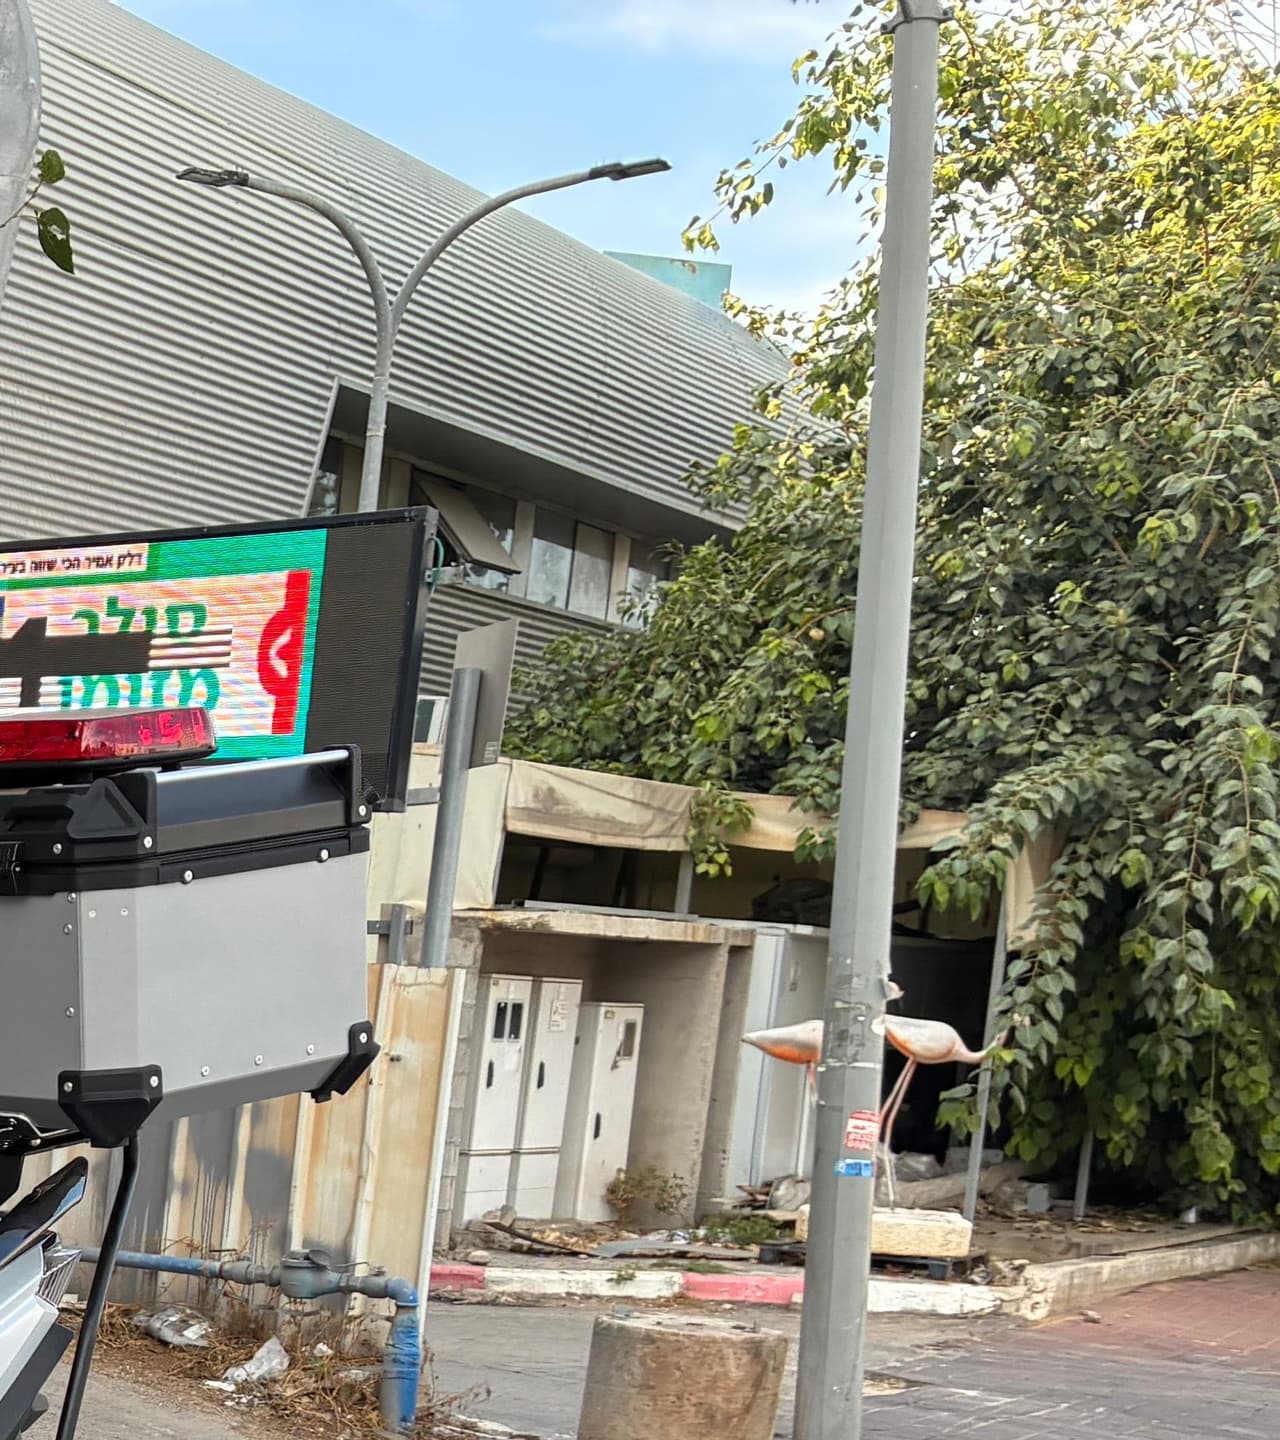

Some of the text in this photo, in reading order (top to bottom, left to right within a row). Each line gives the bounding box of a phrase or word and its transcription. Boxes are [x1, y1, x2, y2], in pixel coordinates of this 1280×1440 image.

[62, 556, 80, 571] הכי
[85, 554, 114, 569] אמיר
[117, 550, 143, 570] דלק
